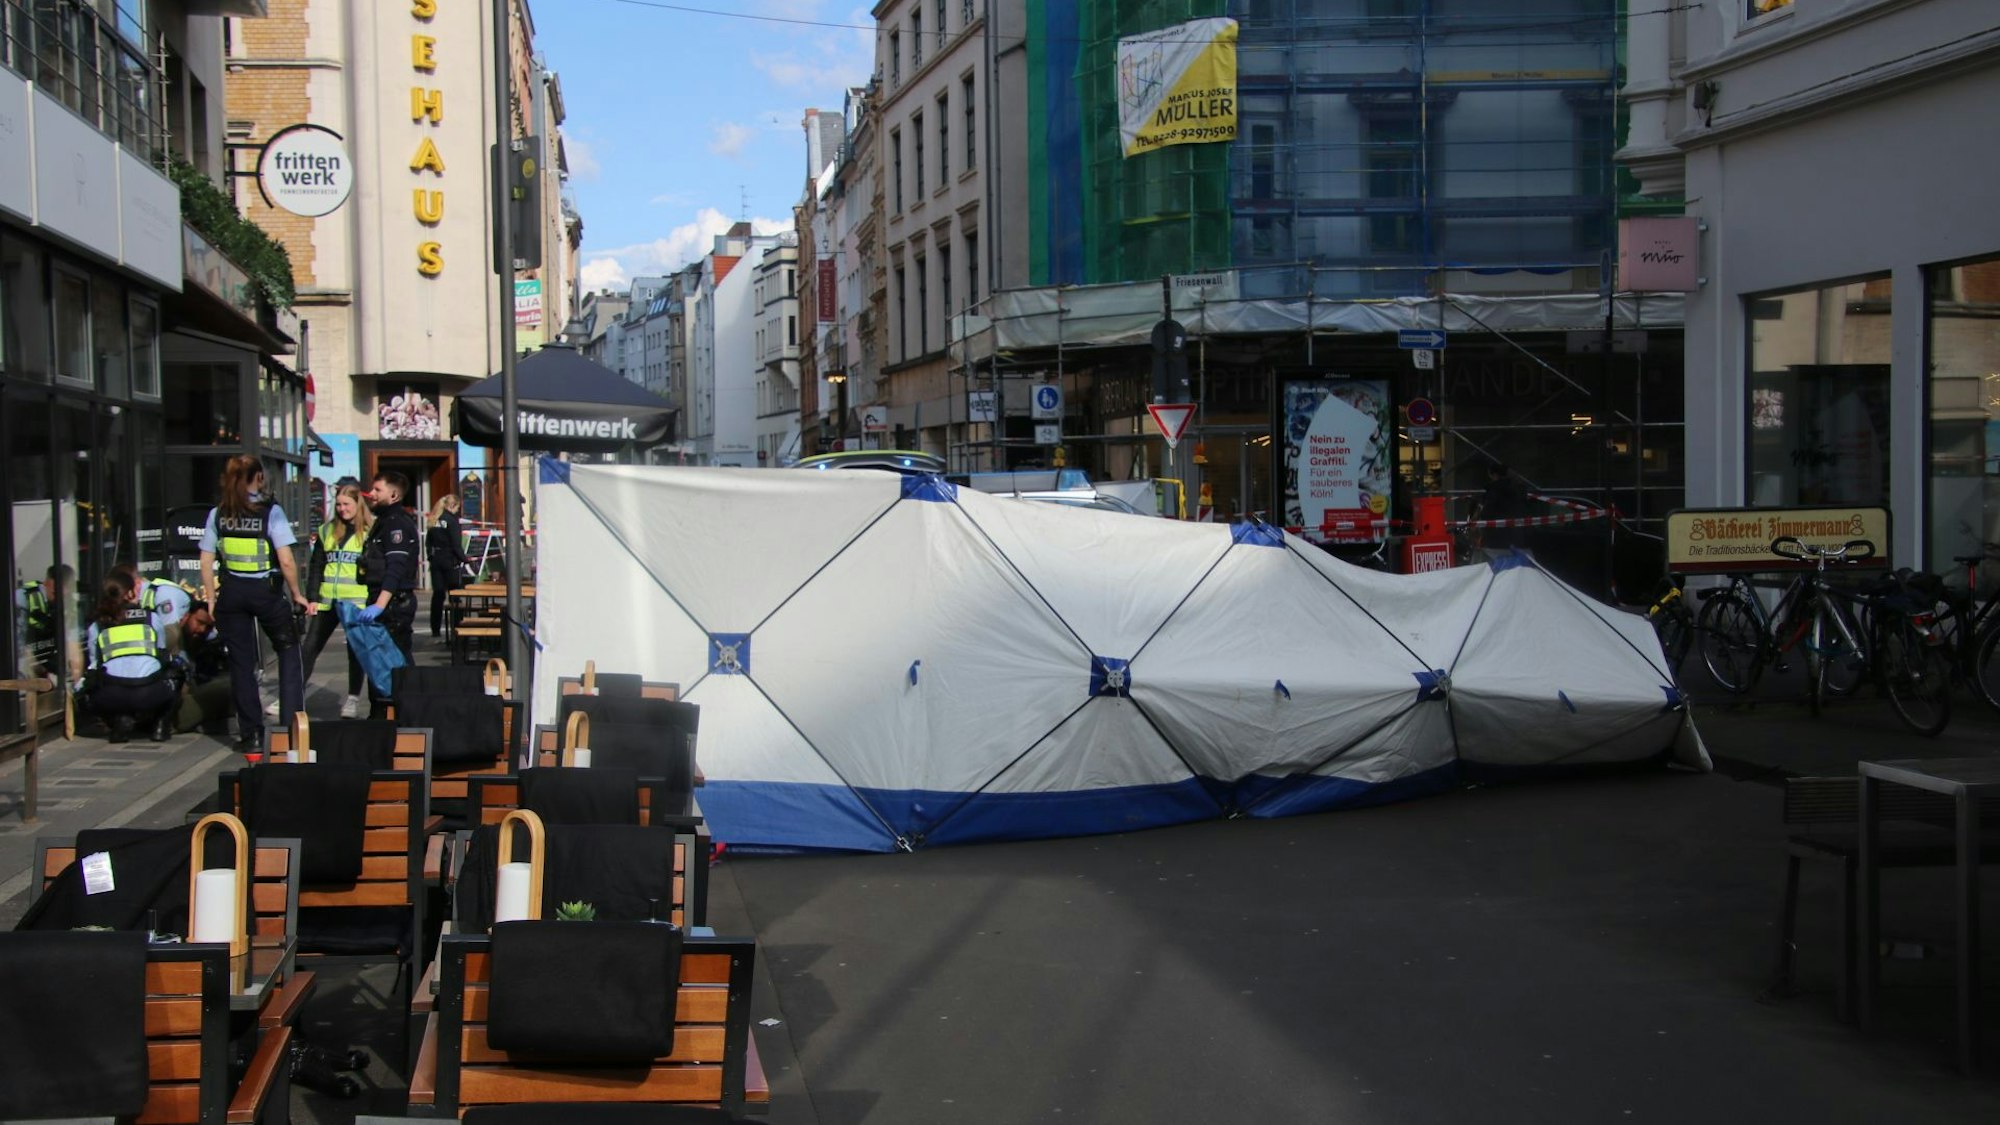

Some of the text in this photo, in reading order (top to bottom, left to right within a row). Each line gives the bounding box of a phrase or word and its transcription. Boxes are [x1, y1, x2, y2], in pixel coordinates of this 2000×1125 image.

[1168, 87, 1233, 104] MARCUS JOSEF
[1155, 98, 1233, 127] MÜLLER
[275, 152, 340, 170] fritten
[281, 166, 335, 185] werk
[1175, 274, 1223, 287] Friesenwall
[1310, 435, 1332, 444] Nein
[1310, 446, 1351, 457] illegalen
[1310, 457, 1348, 466] Graffiti.
[1310, 468, 1343, 477] Für ein
[1310, 478, 1353, 488] sauberes
[1310, 489, 1334, 498] Köln!
[220, 518, 263, 531] POLIZEI
[1704, 515, 1851, 540] Bäckerei Zimmermann
[1688, 546, 1703, 556] Die
[1415, 550, 1447, 572] EXPRESS
